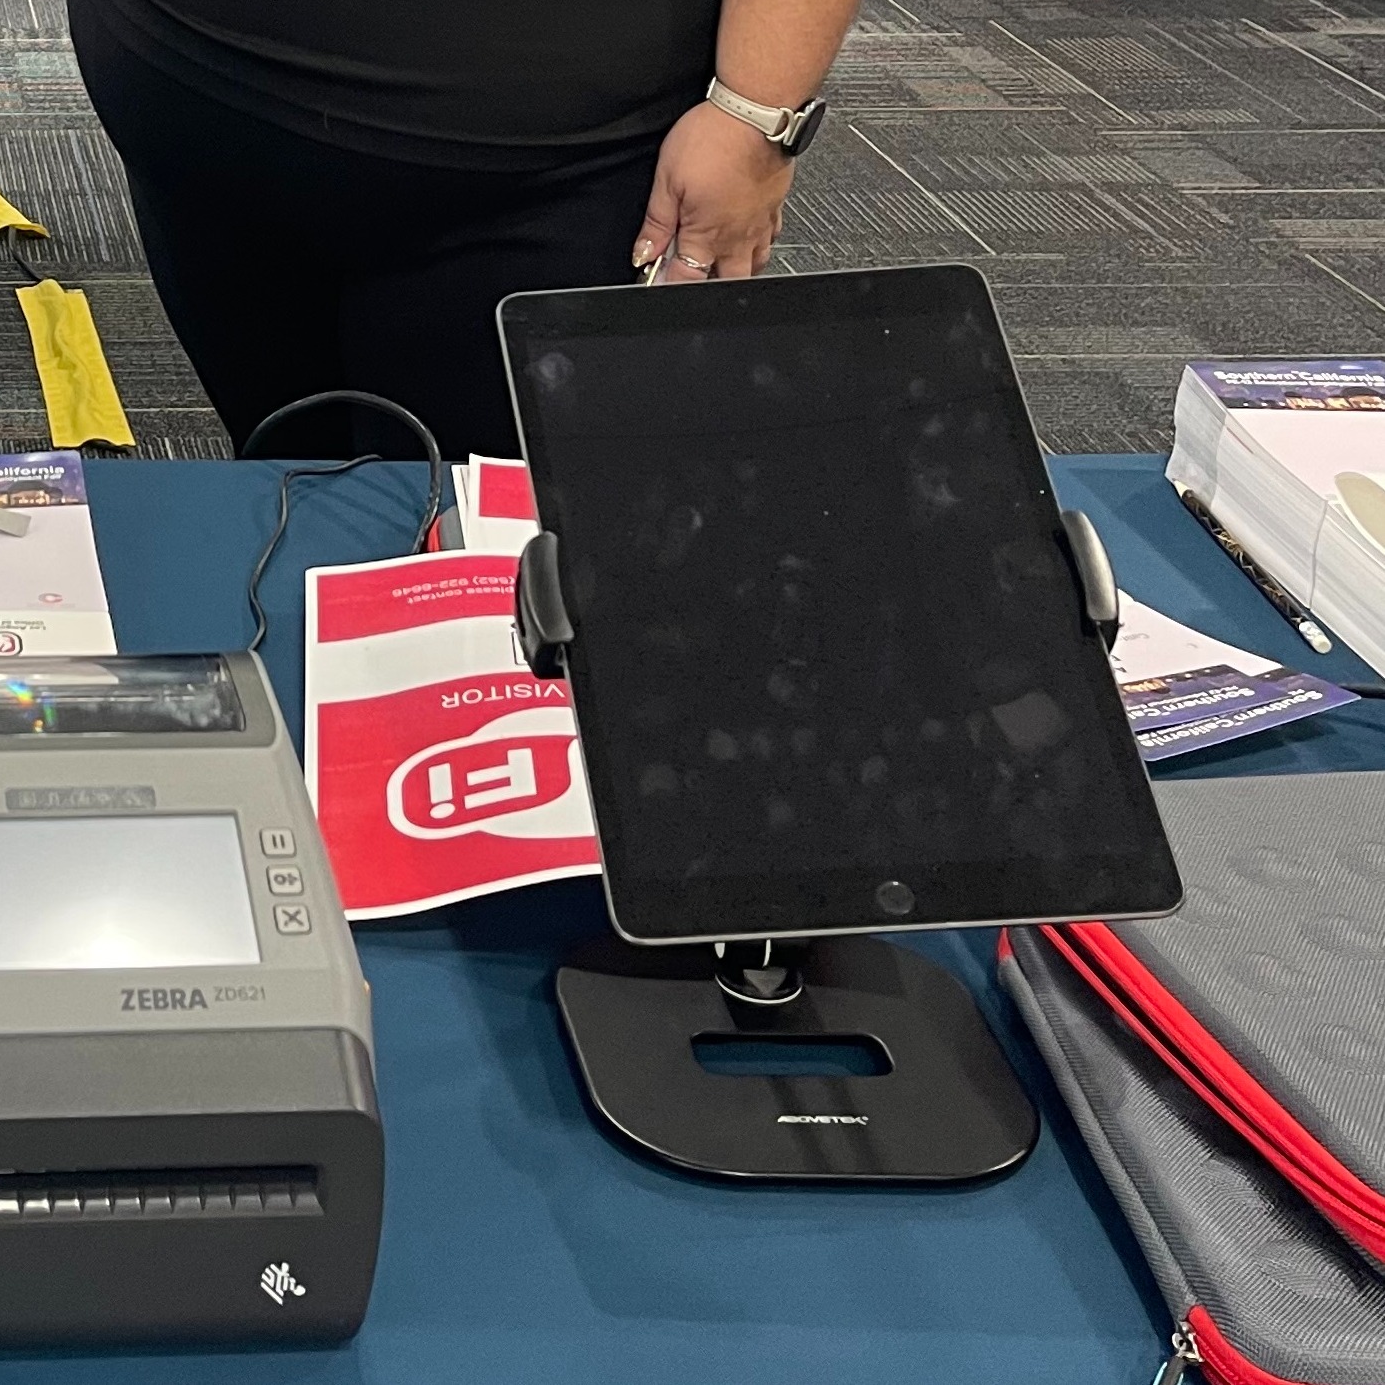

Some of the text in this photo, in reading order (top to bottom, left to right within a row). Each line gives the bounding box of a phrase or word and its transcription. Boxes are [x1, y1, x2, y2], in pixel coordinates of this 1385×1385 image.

[1213, 371, 1298, 381] Southern
[406, 586, 515, 604] please contact
[441, 683, 565, 709] VISITOR
[1167, 687, 1256, 711] Southern
[1139, 690, 1324, 747] Southern California
[428, 747, 538, 820] Fi
[120, 985, 267, 1011] ZEBRA ZD621
